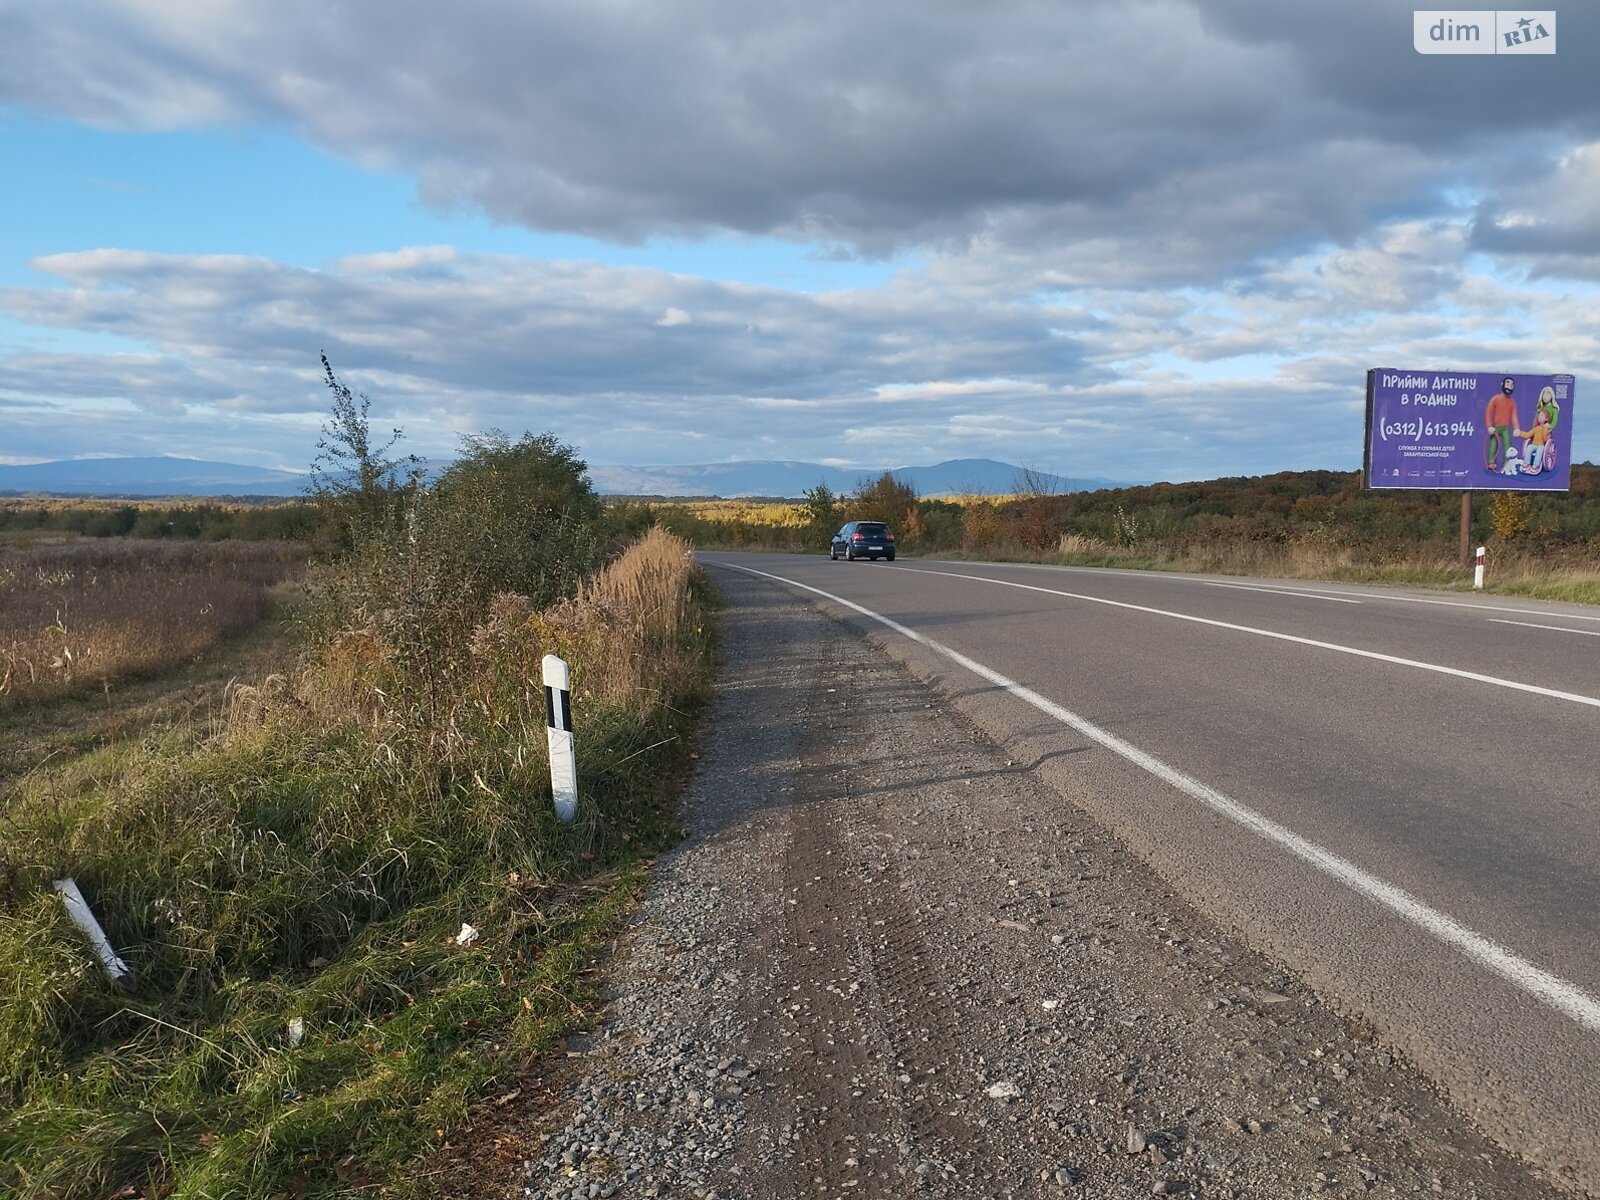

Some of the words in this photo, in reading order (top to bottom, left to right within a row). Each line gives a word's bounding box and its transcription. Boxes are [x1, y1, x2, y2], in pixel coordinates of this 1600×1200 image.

[1383, 374, 1427, 389] ПРИЙМИ
[1432, 376, 1476, 390] ДИТИНУ
[1401, 393, 1409, 405] В
[1414, 393, 1457, 406] РОДИНУ
